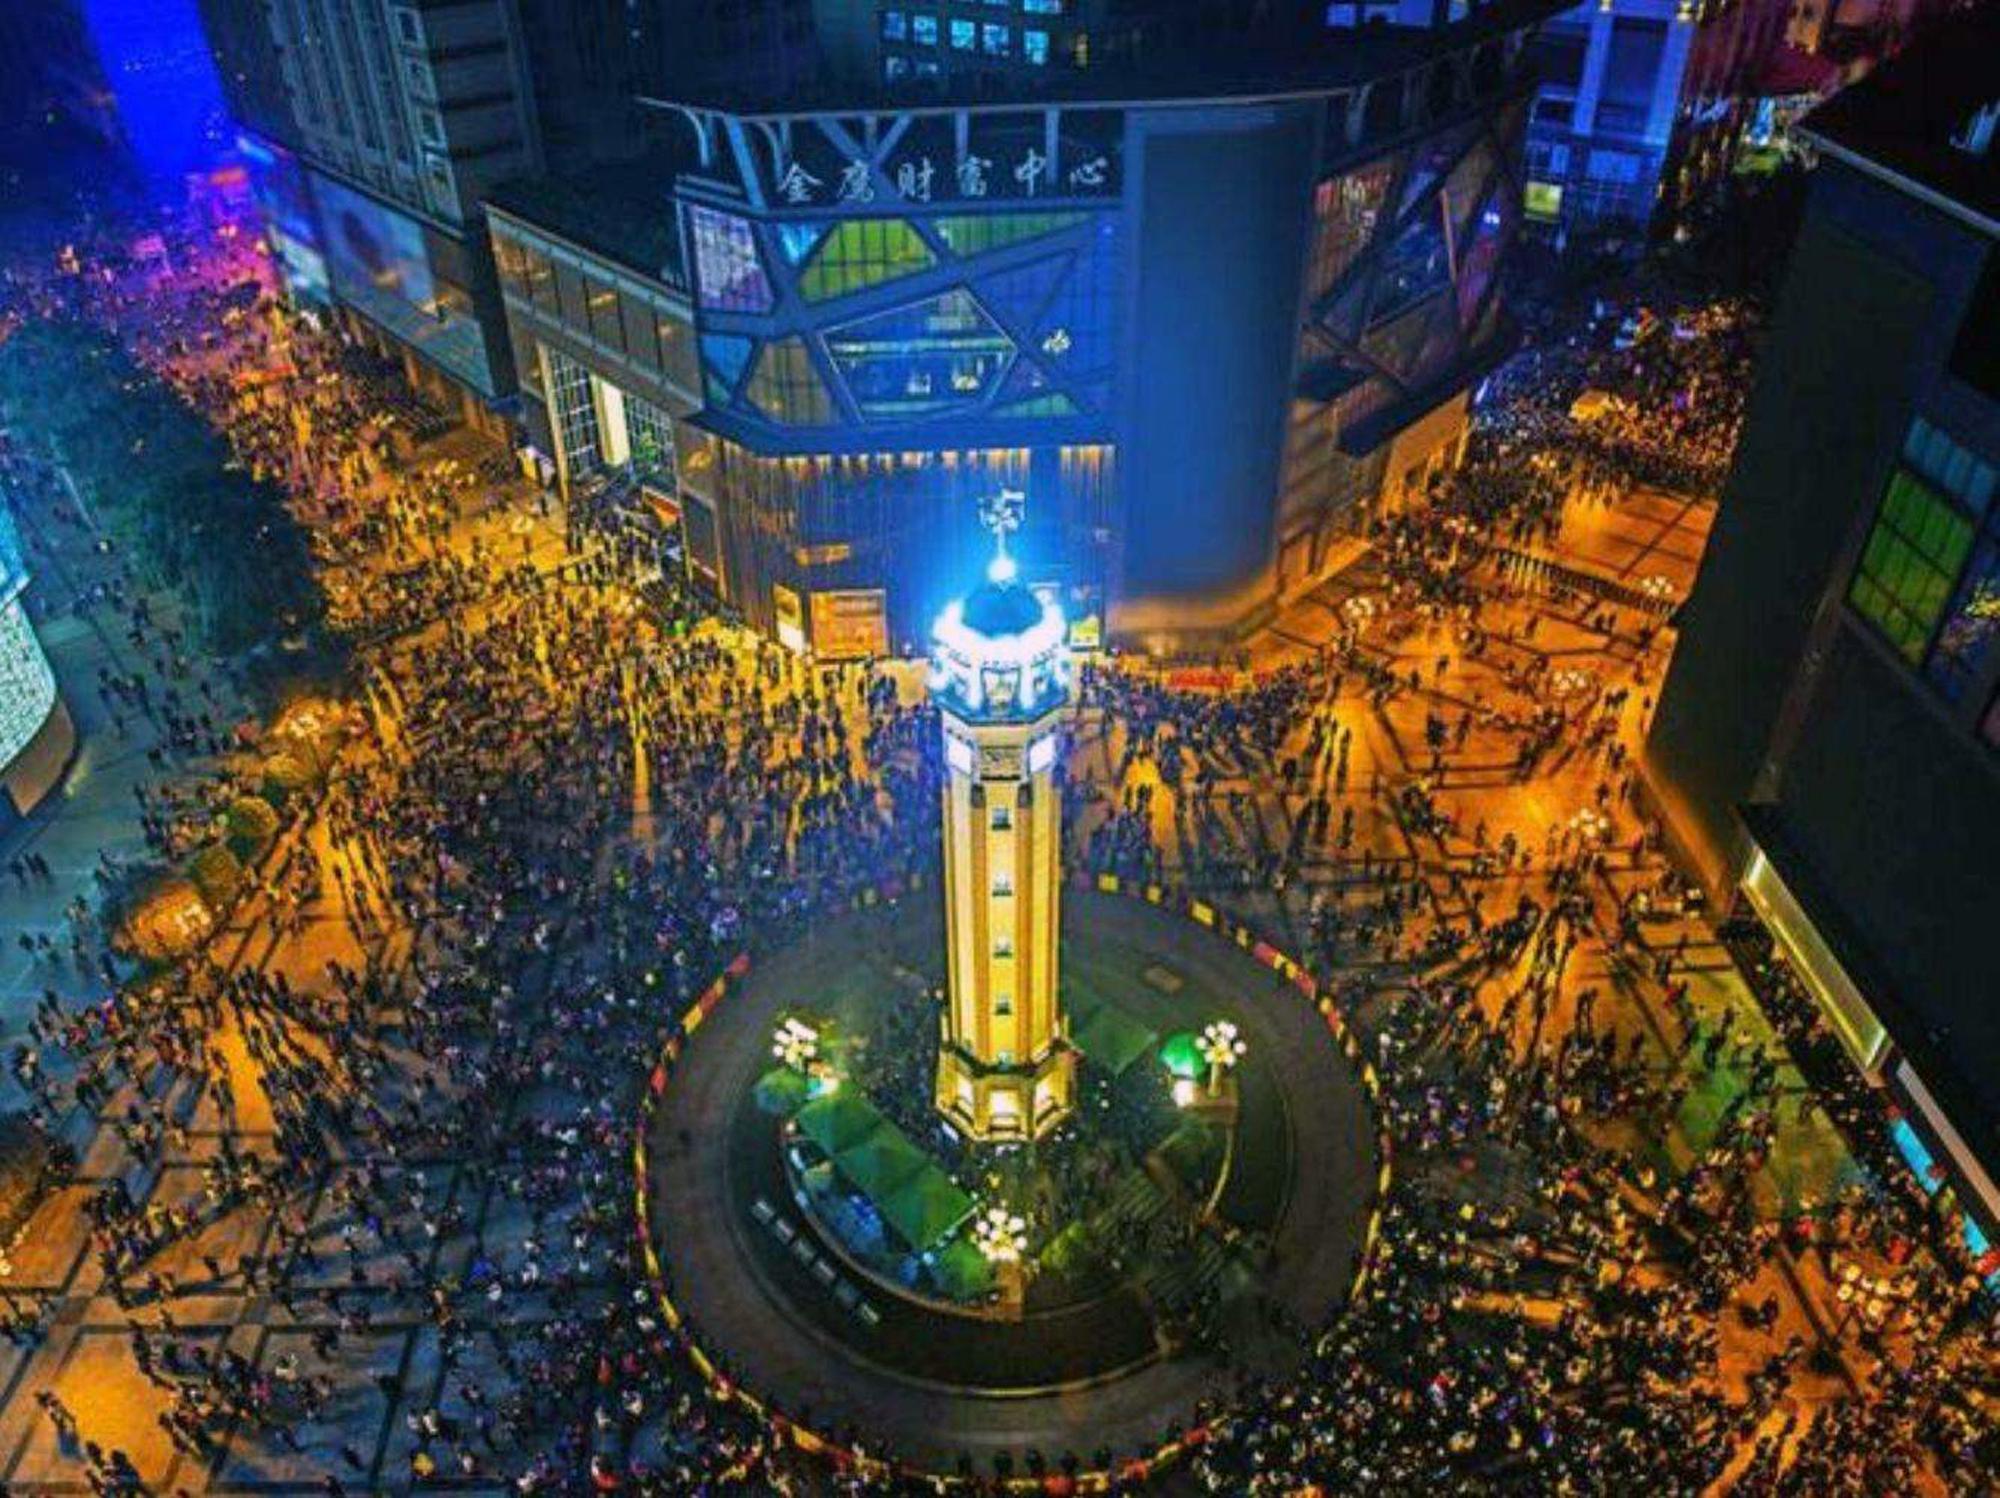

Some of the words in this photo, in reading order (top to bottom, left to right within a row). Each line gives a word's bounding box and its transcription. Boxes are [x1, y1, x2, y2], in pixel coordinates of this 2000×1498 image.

[779, 148, 1107, 203] 金鹰财富中心
